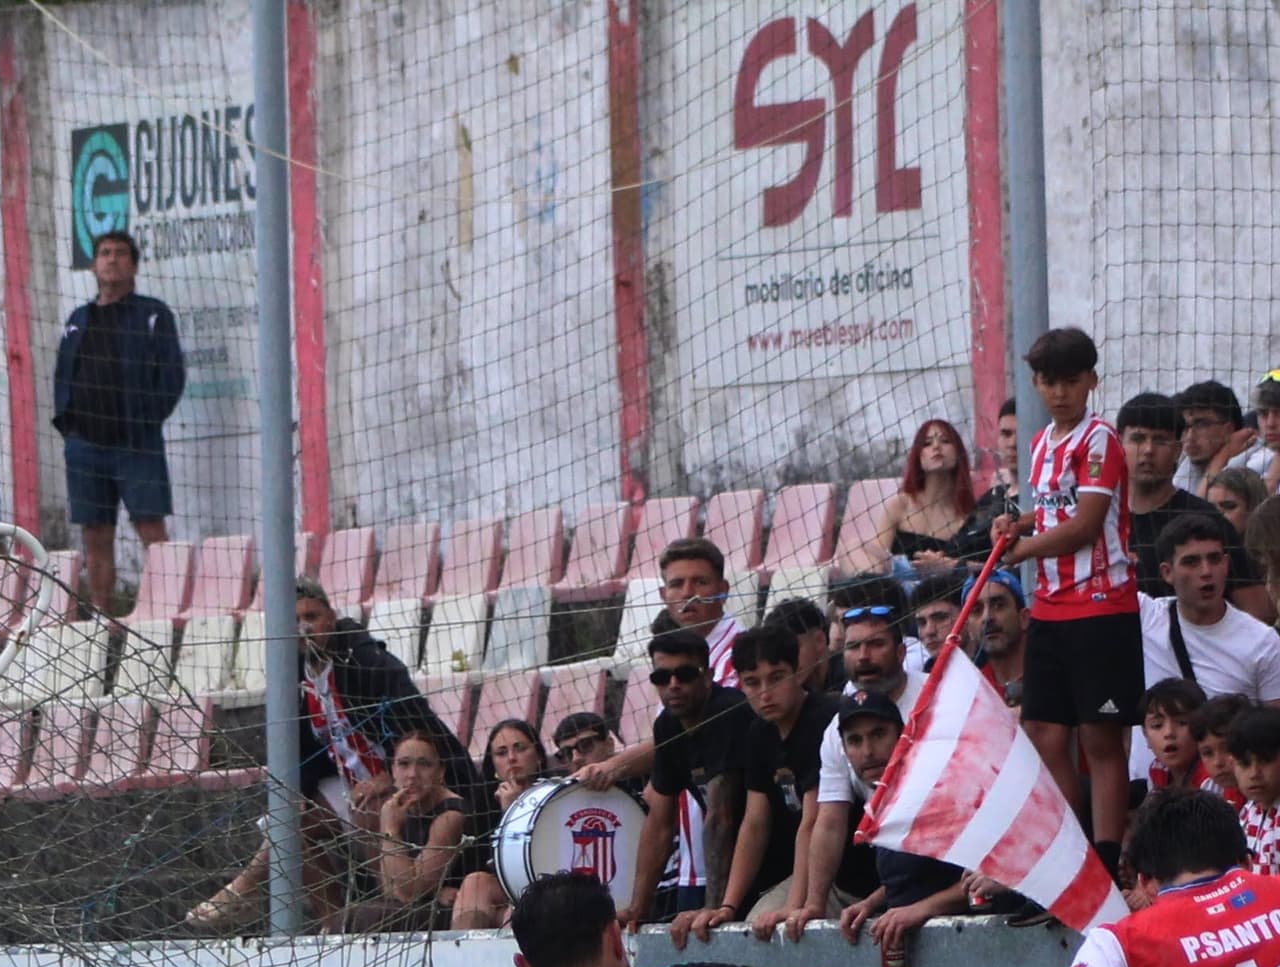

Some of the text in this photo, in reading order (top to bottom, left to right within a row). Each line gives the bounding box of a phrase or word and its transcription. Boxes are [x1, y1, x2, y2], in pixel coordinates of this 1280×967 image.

[744, 262, 914, 303] mobiliario de oficina
